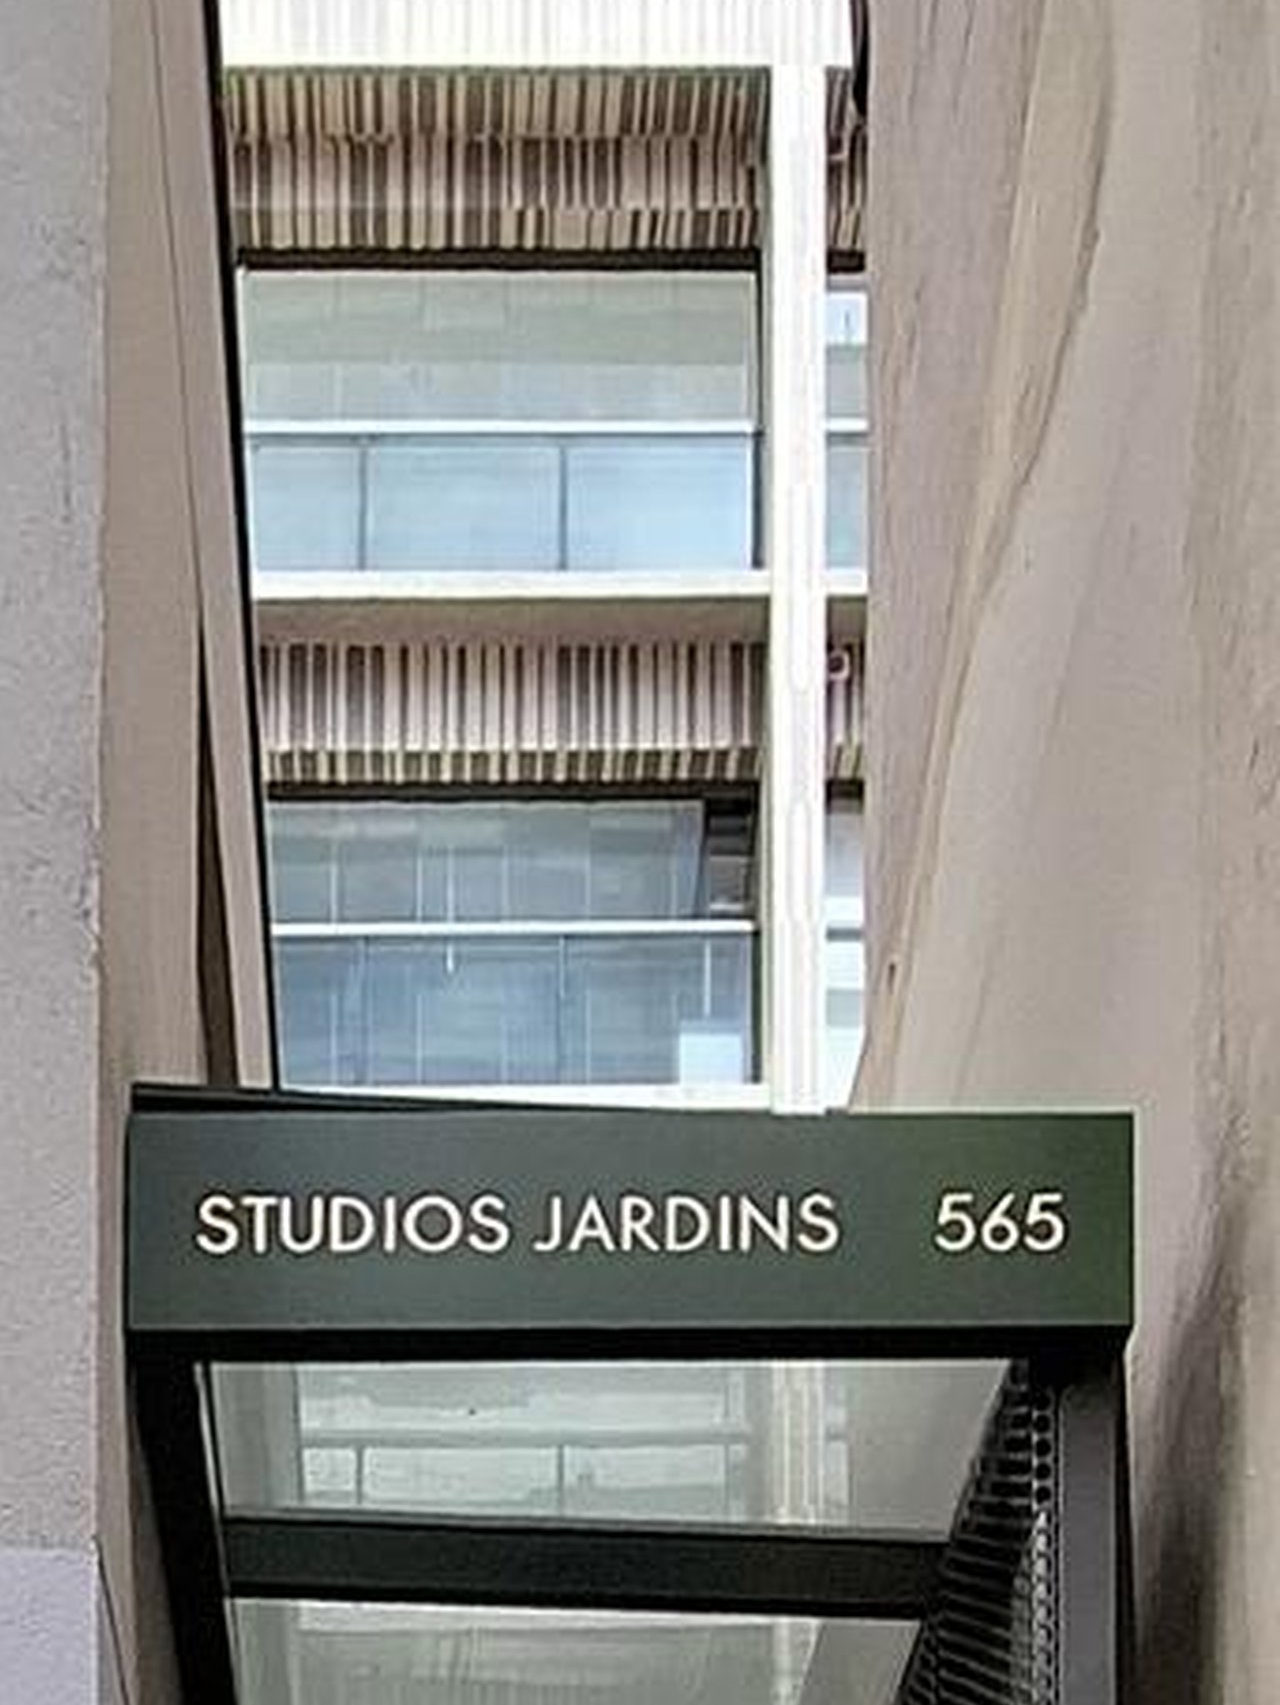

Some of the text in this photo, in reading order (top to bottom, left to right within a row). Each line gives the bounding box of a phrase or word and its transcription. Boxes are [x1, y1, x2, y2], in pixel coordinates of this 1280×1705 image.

[195, 1191, 1067, 1255] STUDIOS JARDINS 565
